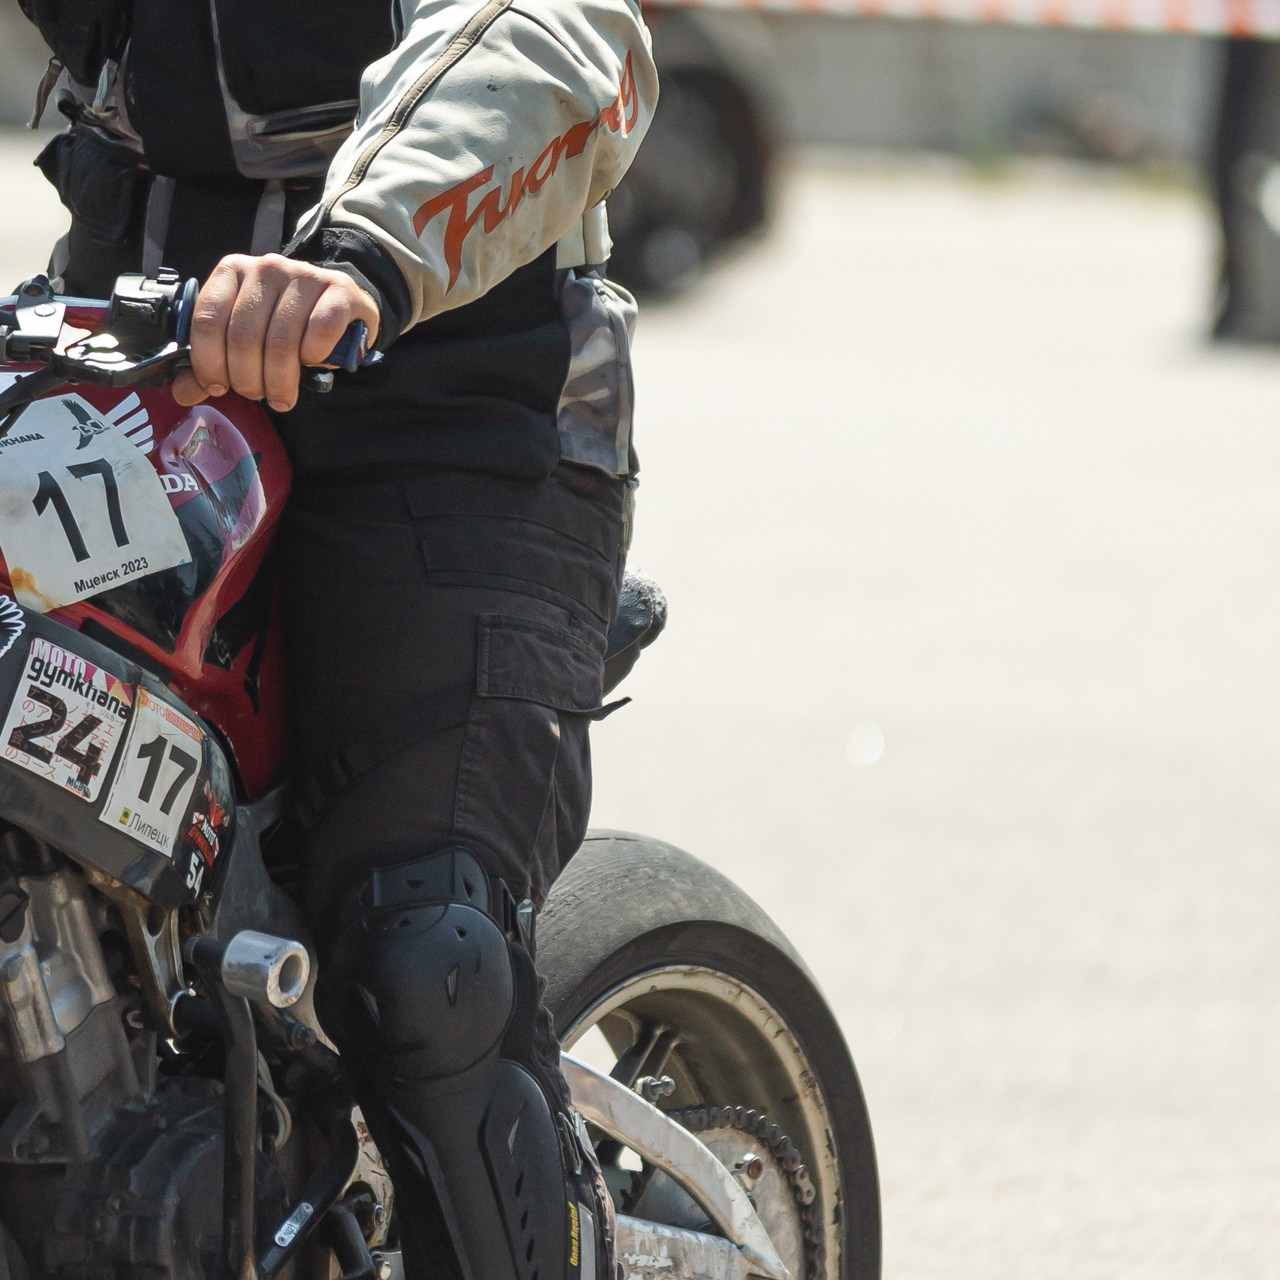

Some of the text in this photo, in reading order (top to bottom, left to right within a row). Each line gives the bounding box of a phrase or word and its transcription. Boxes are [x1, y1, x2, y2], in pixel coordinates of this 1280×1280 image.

[32, 457, 130, 563] 17
[74, 557, 149, 594] Мценск 2023
[26, 657, 130, 719] gymkhana
[33, 639, 86, 677] MOTO
[8, 684, 104, 786] 24
[137, 734, 199, 816] 17
[128, 812, 170, 849] Липецк
